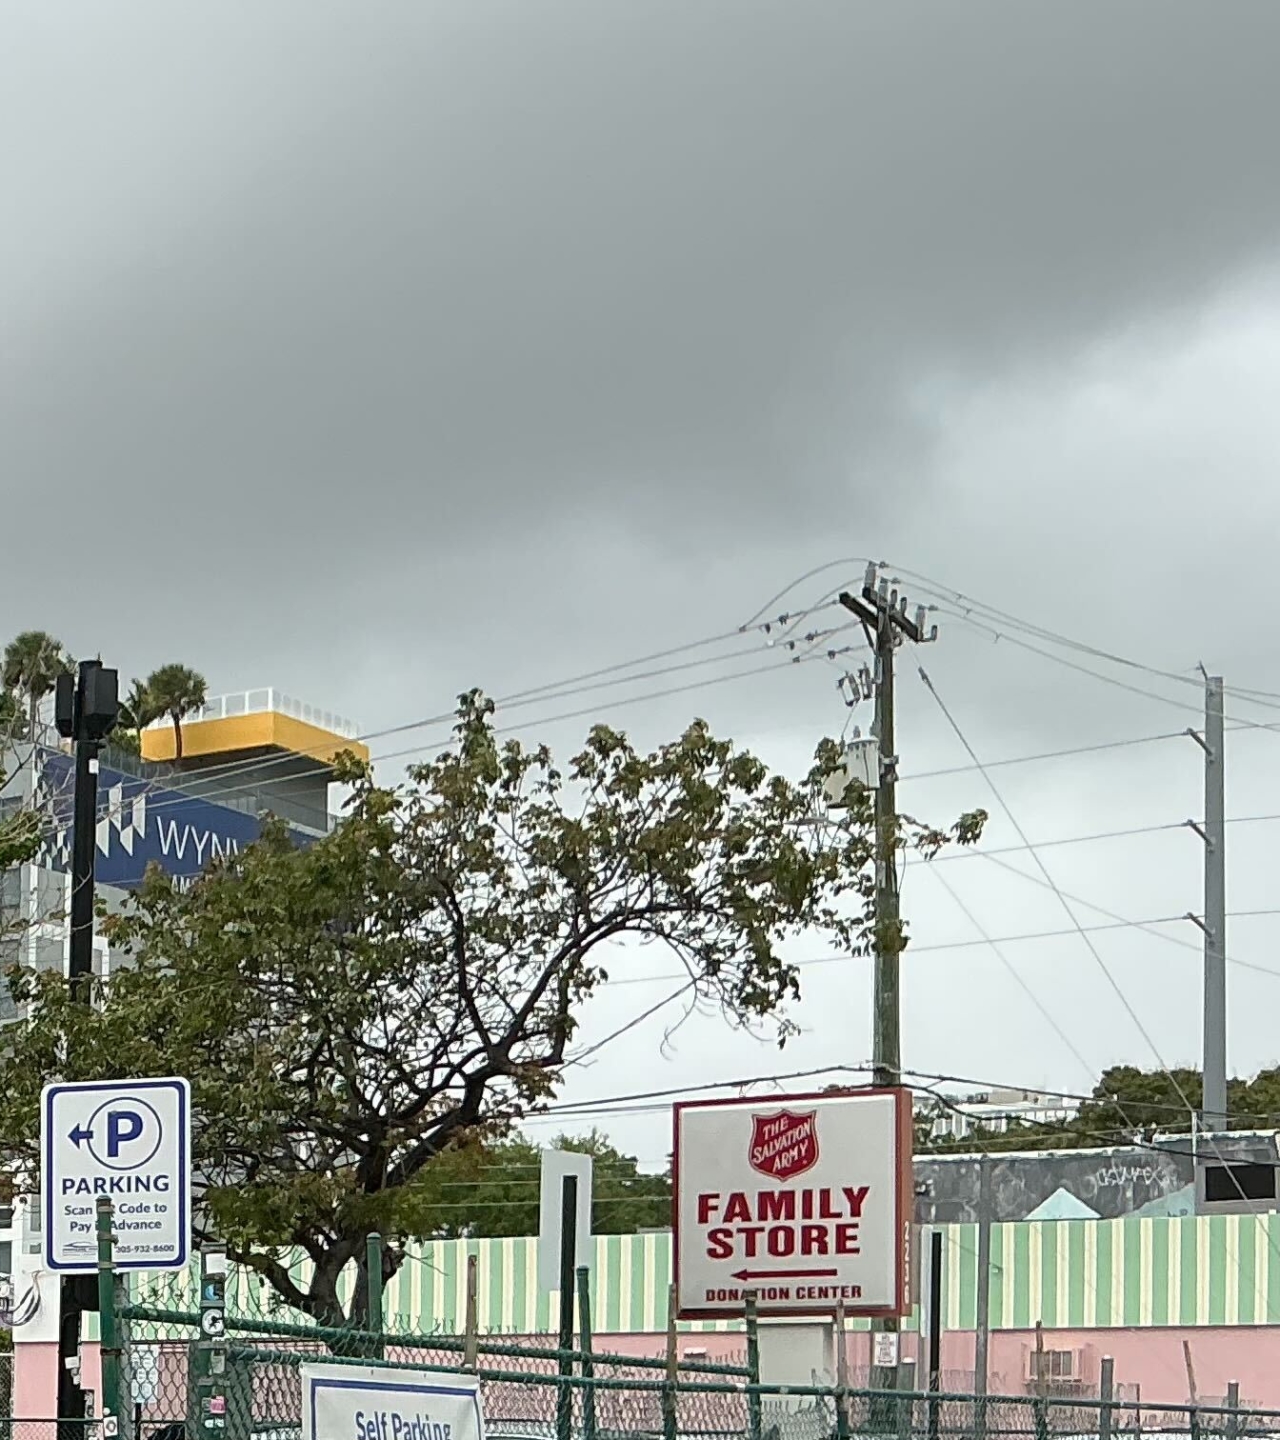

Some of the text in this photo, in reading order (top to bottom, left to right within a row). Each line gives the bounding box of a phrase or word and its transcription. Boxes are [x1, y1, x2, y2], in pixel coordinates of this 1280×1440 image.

[107, 1111, 144, 1157] P
[763, 1116, 789, 1140] THE
[752, 1119, 811, 1165] SALVATION
[773, 1139, 809, 1173] ARMY
[62, 1175, 170, 1195] PARKING
[64, 1205, 93, 1216] Scan
[119, 1203, 151, 1214] Code
[155, 1203, 167, 1213] to
[697, 1186, 870, 1225] FAMILY
[70, 1221, 92, 1234] Pay
[111, 1219, 162, 1231] Advance
[115, 1244, 175, 1254] 305-932-8600
[706, 1223, 861, 1259] STORE
[796, 1285, 862, 1299] CENTER
